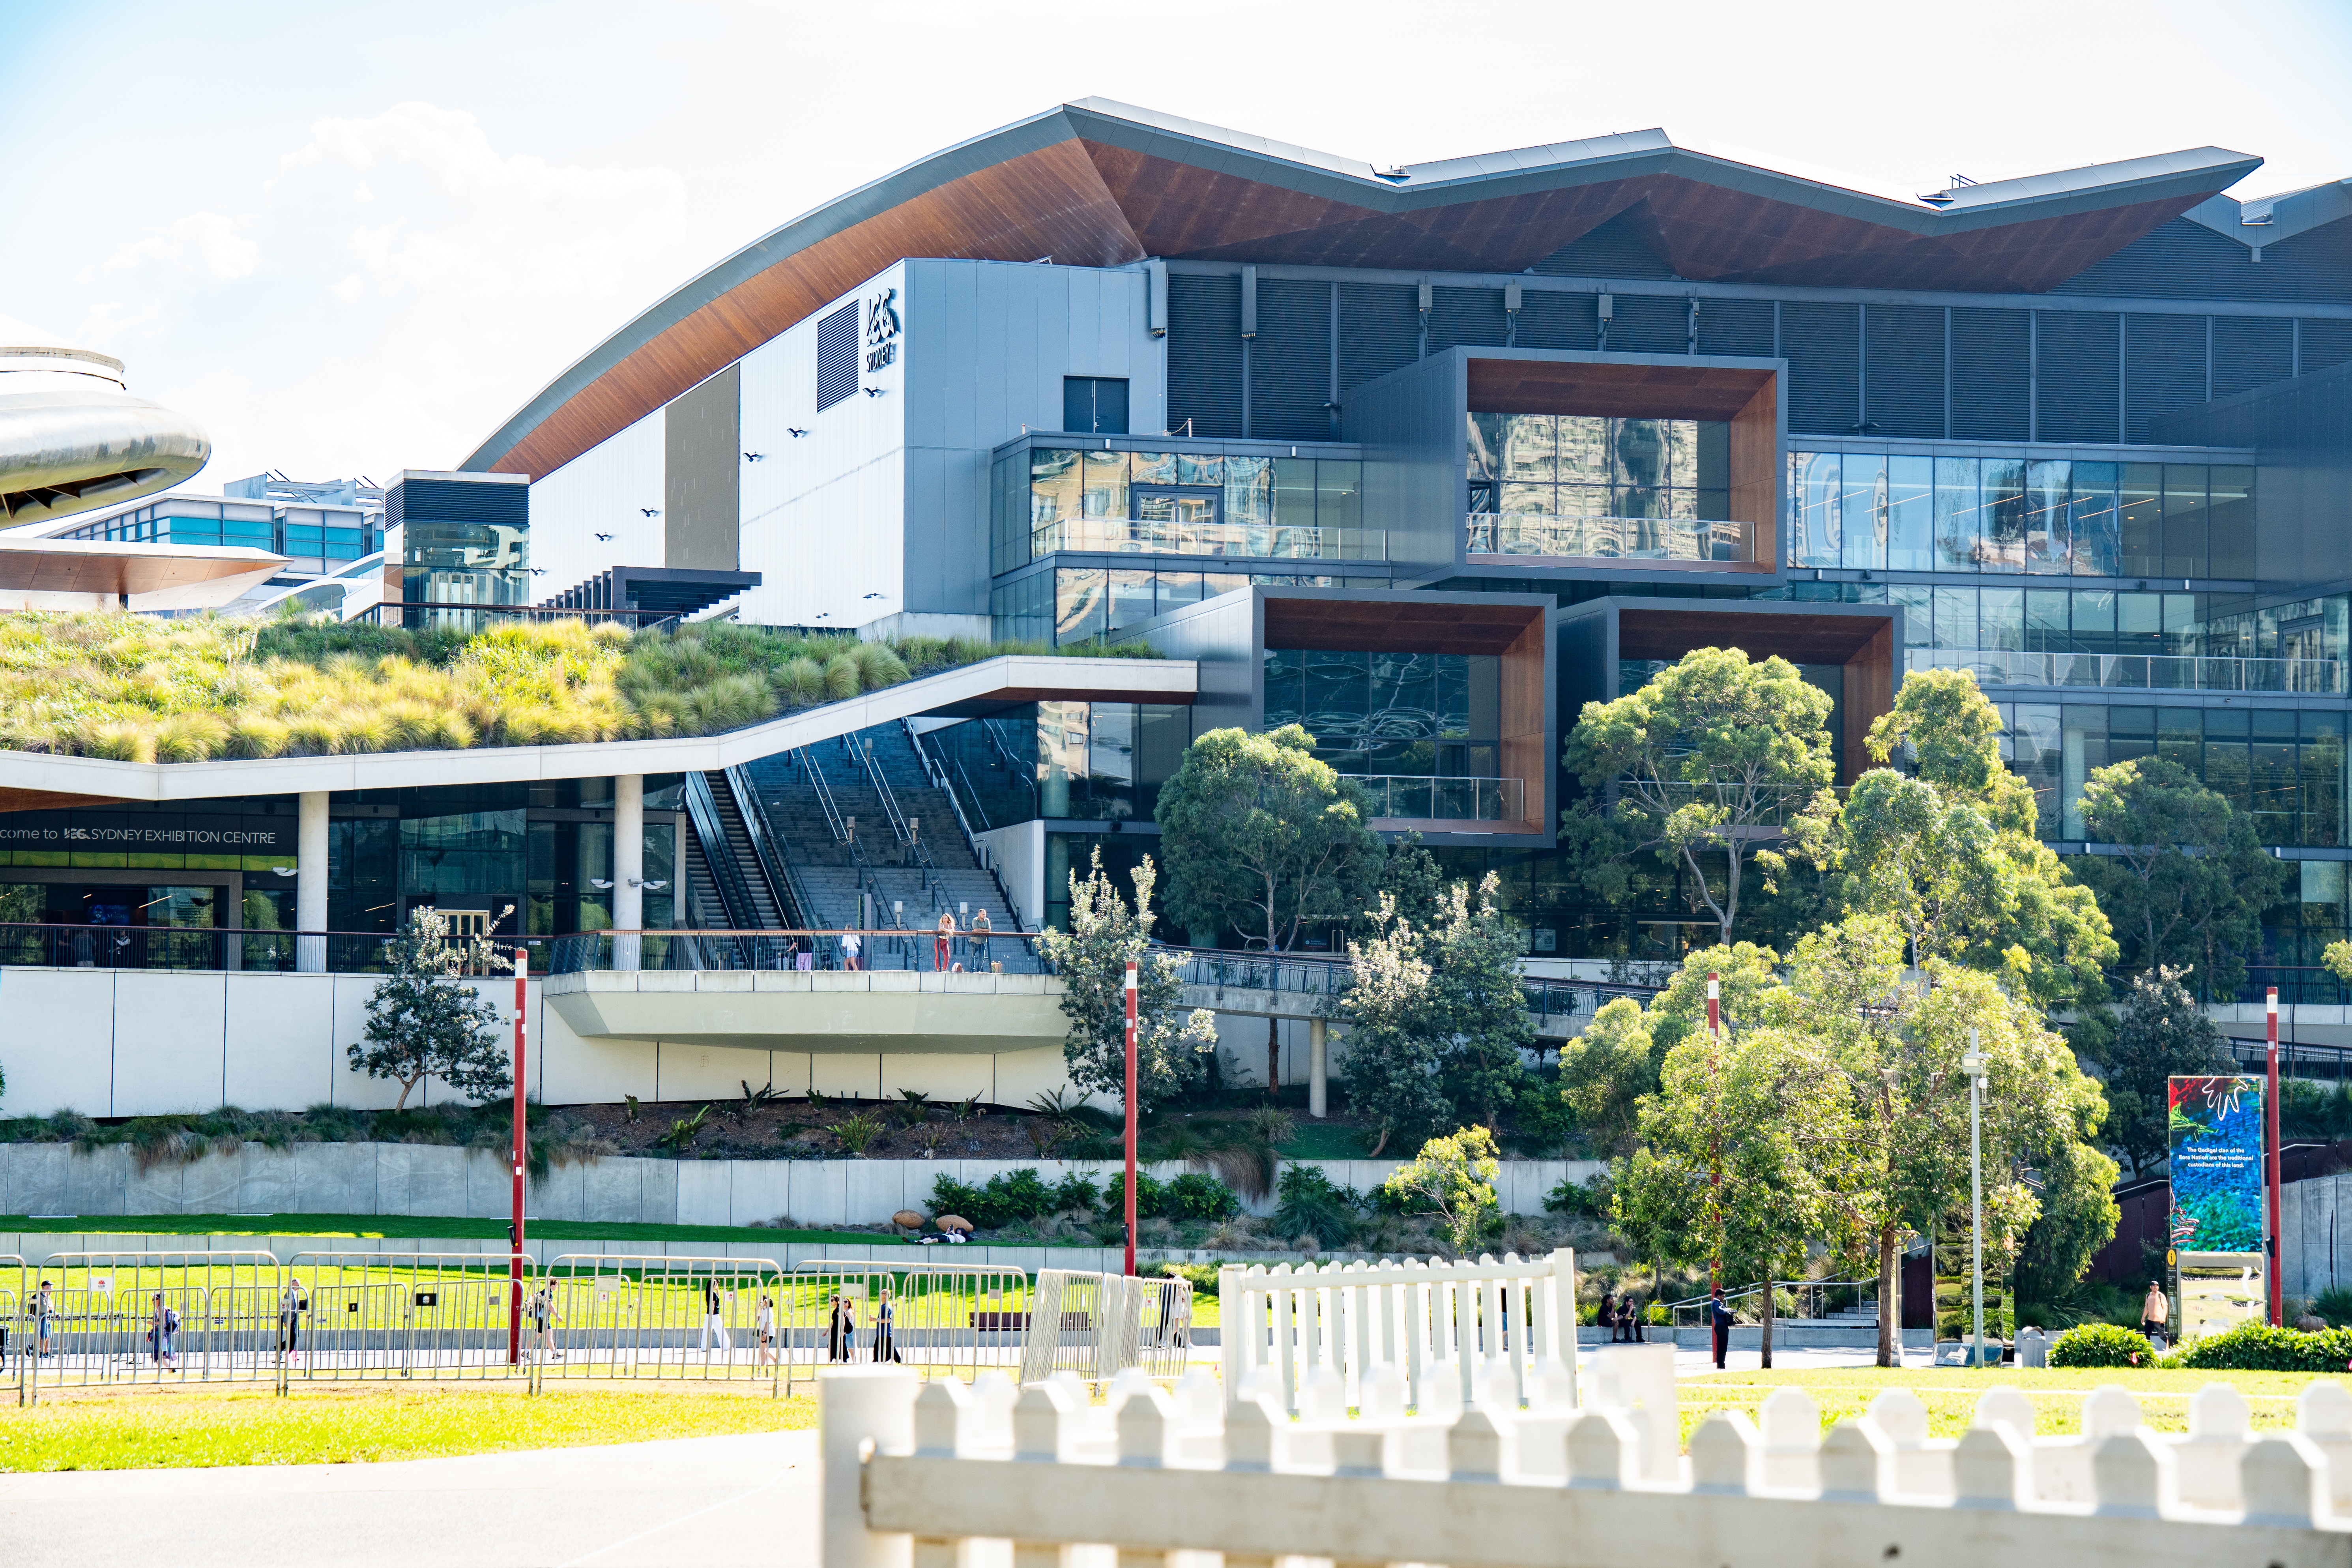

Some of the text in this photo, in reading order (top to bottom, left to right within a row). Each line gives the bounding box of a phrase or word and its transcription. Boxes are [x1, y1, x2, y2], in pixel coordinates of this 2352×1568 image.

[866, 342, 892, 372] SYDNEY
[43, 829, 58, 839] to
[92, 829, 143, 840] SYDNEY
[145, 830, 219, 842] EXHIBITION
[223, 832, 275, 844] CENTRE
